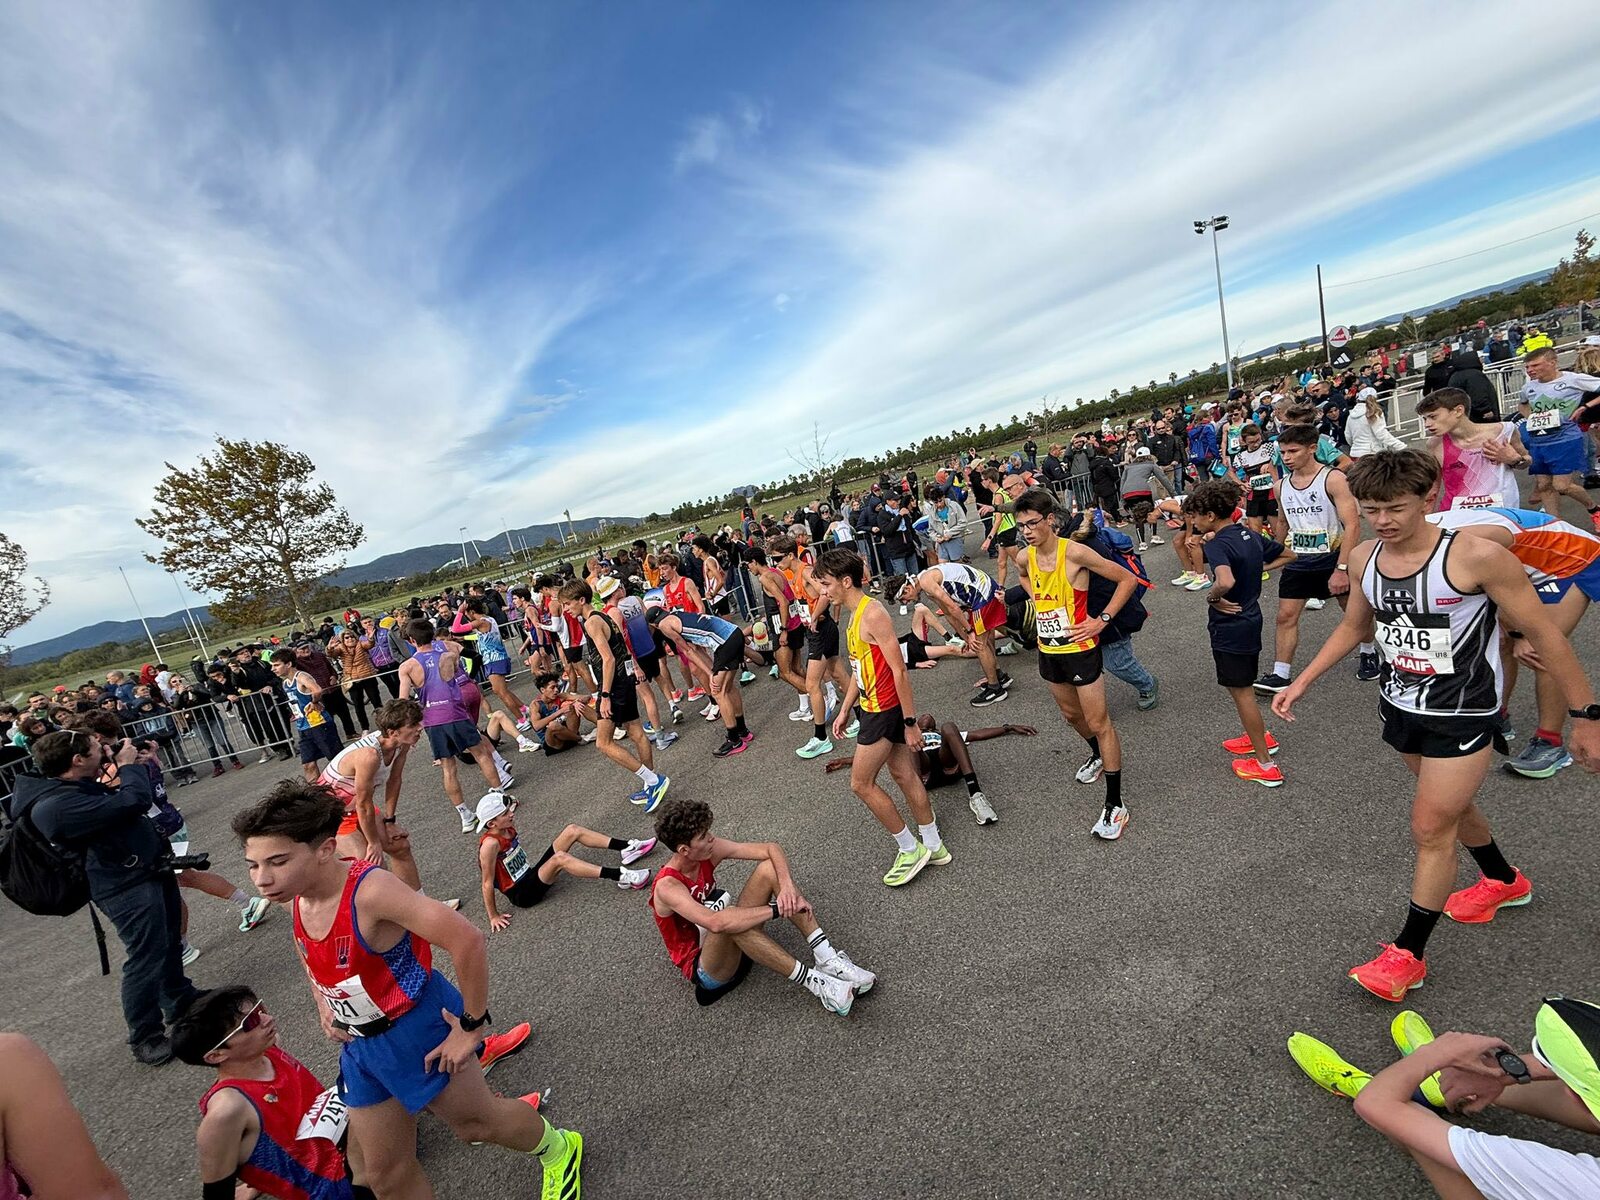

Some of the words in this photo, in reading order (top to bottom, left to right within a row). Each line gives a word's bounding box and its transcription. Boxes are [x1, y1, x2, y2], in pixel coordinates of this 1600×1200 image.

[1531, 417, 1552, 428] 2521
[1463, 496, 1492, 505] MAIF
[1286, 505, 1323, 515] TROYES
[1293, 533, 1318, 547] 5037
[1038, 619, 1062, 633] 2553
[1382, 625, 1431, 651] 2346
[1394, 658, 1432, 672] MAIF
[368, 1012, 381, 1021] U18
